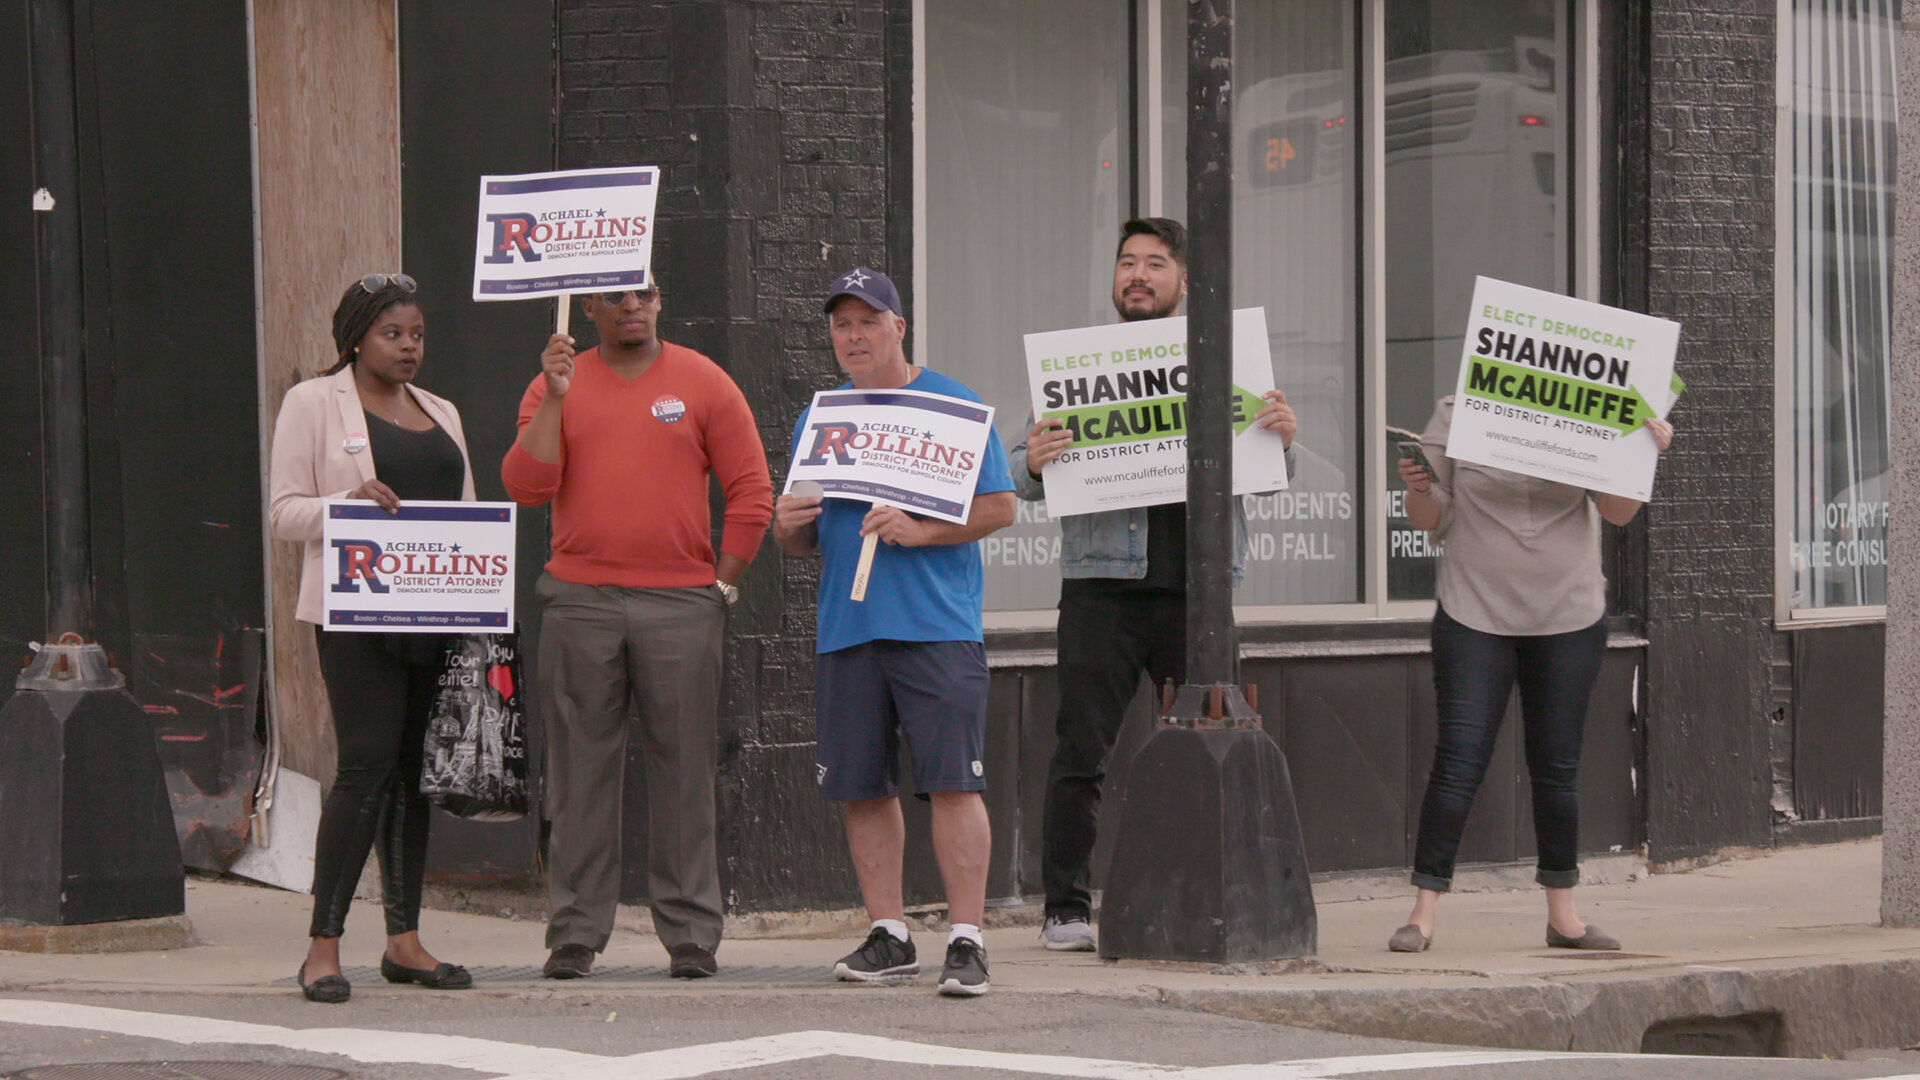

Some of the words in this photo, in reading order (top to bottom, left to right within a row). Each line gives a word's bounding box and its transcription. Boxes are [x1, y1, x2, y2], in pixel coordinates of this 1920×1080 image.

[500, 216, 647, 250] ROLLINS
[545, 241, 587, 253] DISTRICT
[590, 238, 643, 250] ATTORNEY
[547, 252, 578, 260] DEMOCRAT
[1482, 305, 1536, 328] ELECT
[1542, 319, 1636, 351] DEMOCRAT
[1041, 353, 1102, 372] ELECT
[1476, 327, 1630, 387] SHANNON
[1043, 365, 1187, 409] SHANNO
[1465, 398, 1489, 413] FOR
[1494, 405, 1550, 426] DISTRICT
[1553, 419, 1618, 442] ATTORNEY
[817, 426, 975, 471] ROLLINS
[1087, 443, 1150, 461] DISTRICT
[1485, 429, 1598, 463] www.mcauliffeforda.com
[861, 450, 907, 466] DISTRICT
[910, 459, 968, 481] ATTORNEY
[862, 461, 896, 471] DEMOCRAT
[937, 476, 963, 486] COUNTY
[1084, 464, 1186, 486] www.mcauliffeford
[1242, 492, 1351, 520] CCIDENTS
[1282, 533, 1336, 560] FALL
[1790, 541, 1831, 567] FREE
[345, 545, 508, 579] ROLLINS
[393, 575, 440, 587] DISTRICT
[445, 575, 504, 587] ATTORNEY
[354, 614, 377, 622] Boston
[382, 615, 411, 623] Chelsea
[417, 615, 449, 624] Winthrop
[445, 650, 480, 667] Tour
